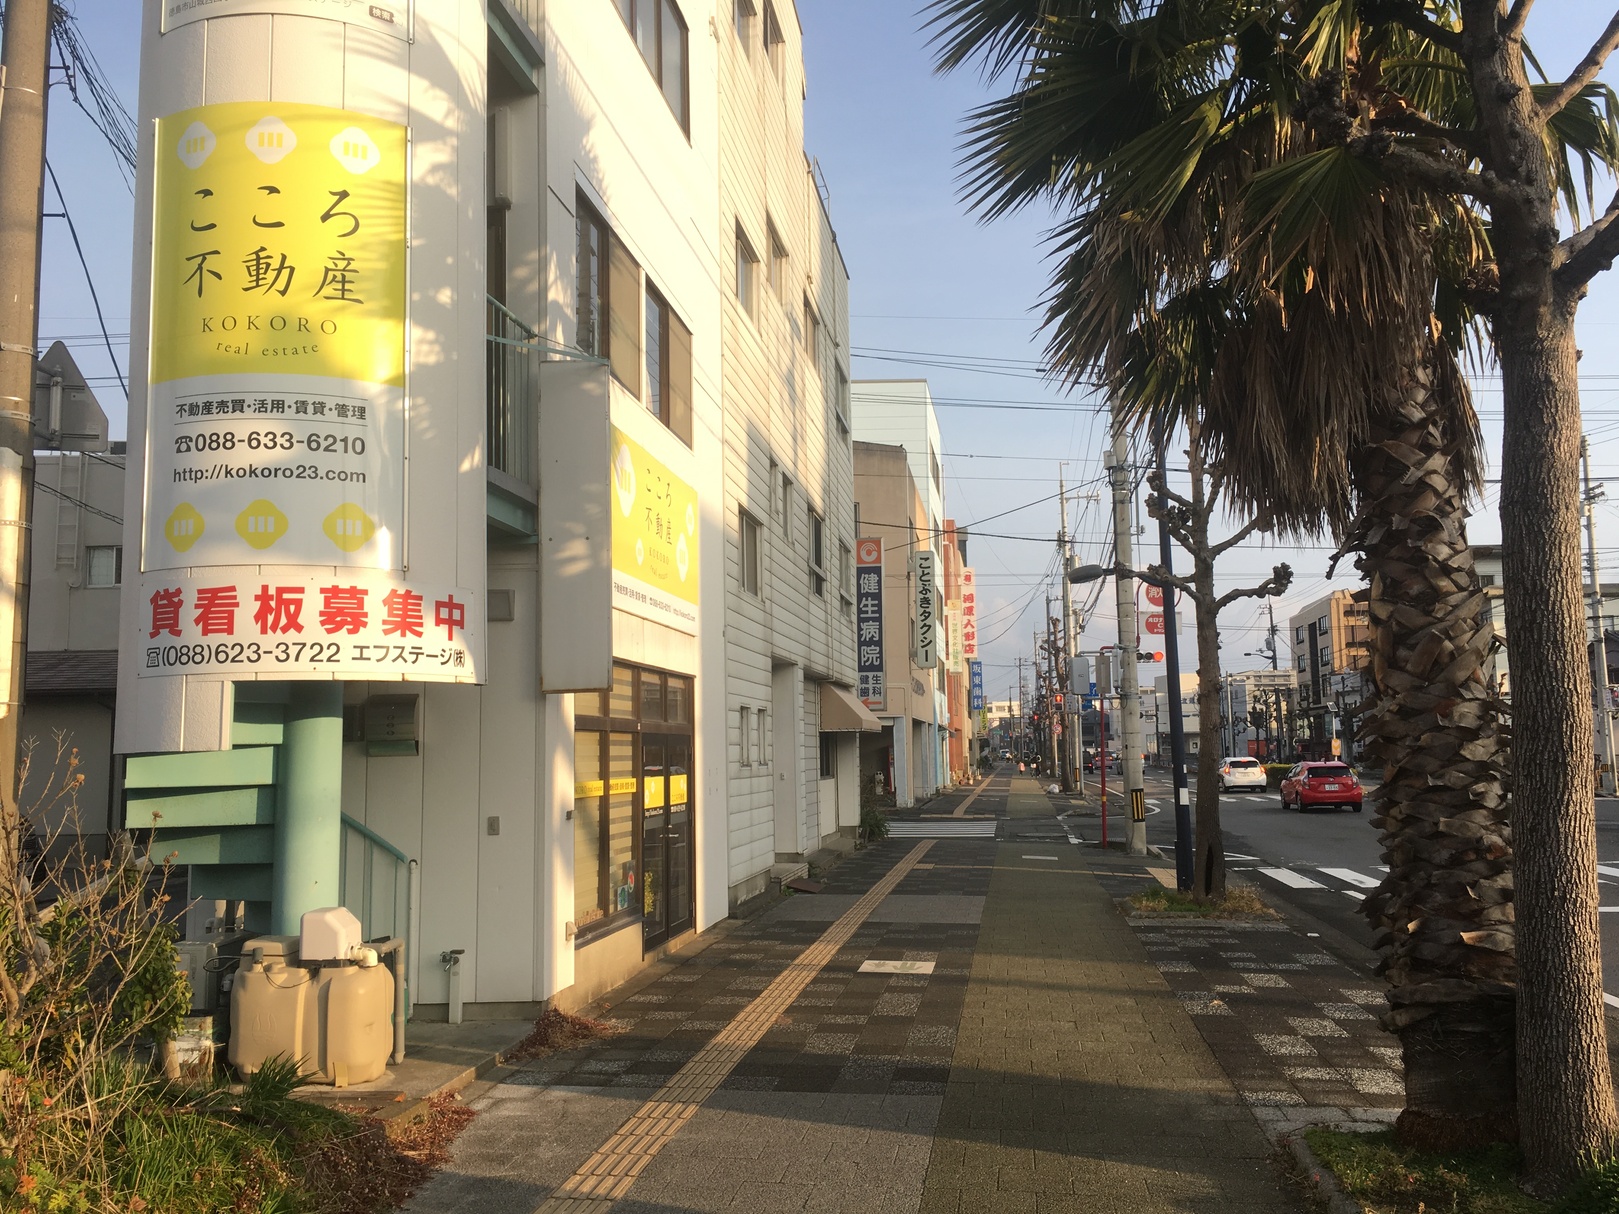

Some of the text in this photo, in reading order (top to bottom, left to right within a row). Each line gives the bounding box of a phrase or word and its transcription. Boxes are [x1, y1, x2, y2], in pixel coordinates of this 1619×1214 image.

[190, 185, 360, 238] こころ
[182, 246, 364, 304] 不動産
[201, 315, 338, 335] KOKORO
[216, 341, 320, 356] real estate
[195, 431, 366, 455] 088-633-6210
[173, 464, 367, 484] http://kokoro23.com
[646, 468, 672, 507] こころ
[645, 507, 673, 545] 不動産
[149, 584, 465, 641] 貸看板募集中
[859, 573, 880, 666] 健生病院
[918, 556, 933, 662] ことぶきタクシー
[161, 642, 341, 667] (088)623-3722
[860, 686, 882, 698] 歯科
